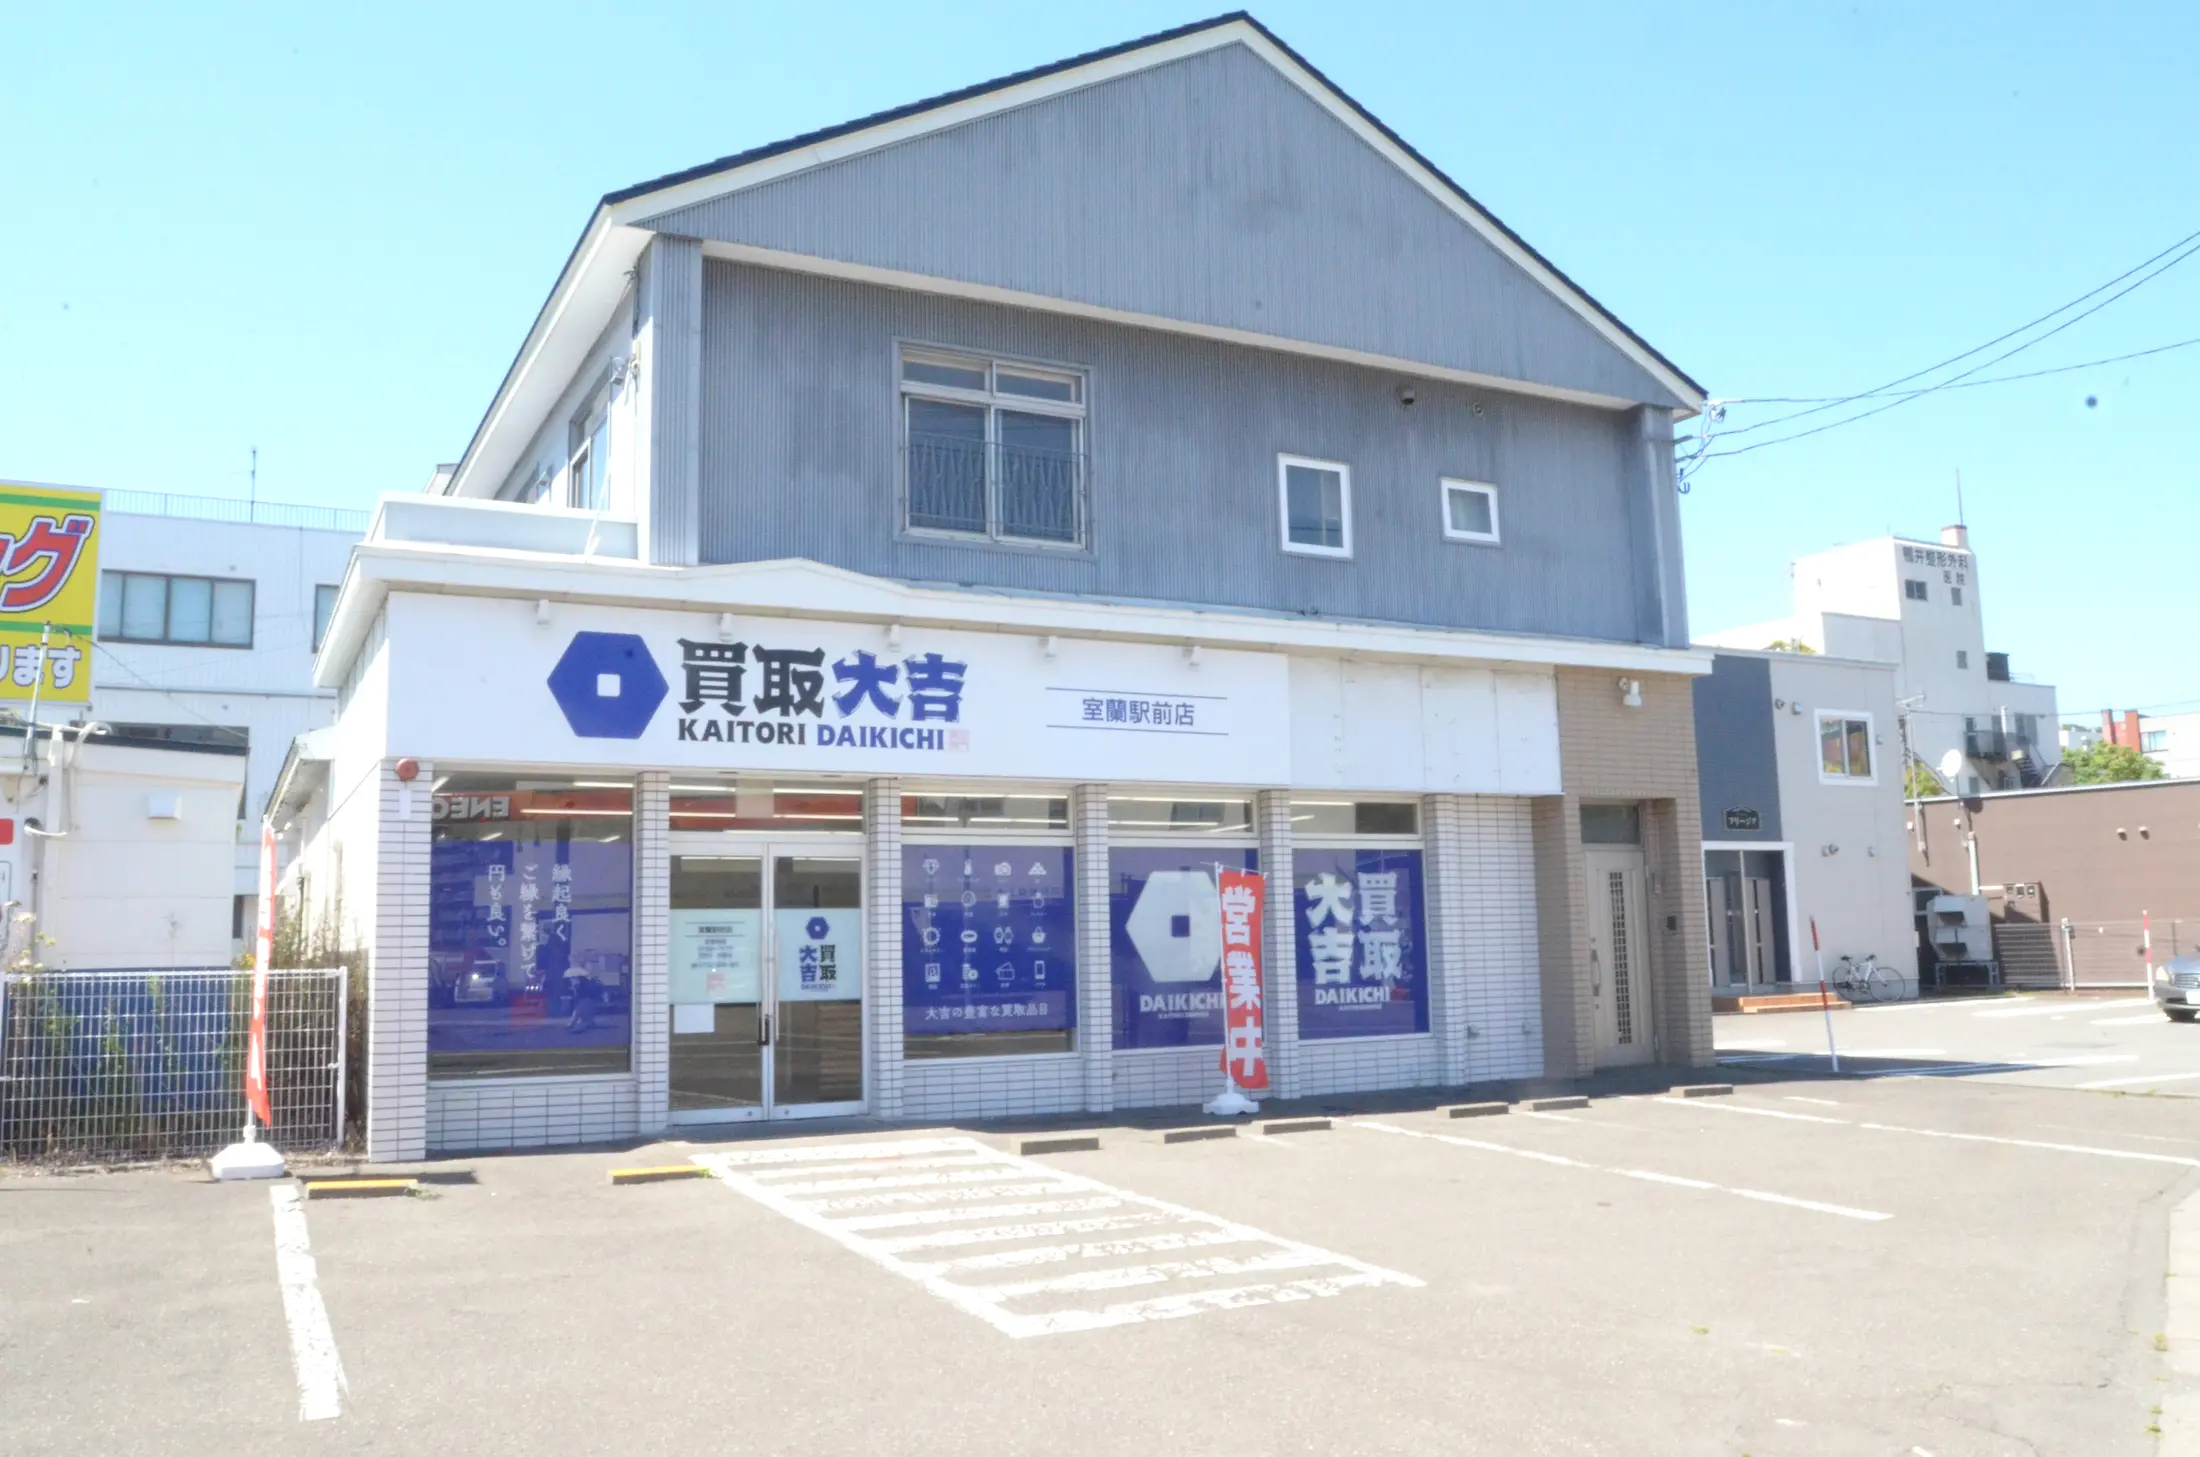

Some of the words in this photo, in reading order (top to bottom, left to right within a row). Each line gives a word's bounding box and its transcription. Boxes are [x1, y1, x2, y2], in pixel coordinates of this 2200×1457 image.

[0, 513, 95, 613] グ
[677, 638, 967, 723] 買取大吉
[1082, 698, 1195, 726] 室蘭駅前店
[677, 718, 806, 746] KAITORI
[817, 724, 945, 750] DAIKICHI
[520, 864, 539, 978] ご縁を繋げて
[552, 864, 572, 941] 縁起良く
[1304, 872, 1355, 985] 大吉
[1357, 872, 1401, 981] 買取
[925, 1002, 1048, 1020] 大吉の豊富な買取品目
[1222, 885, 1262, 1077] 営業中
[1315, 986, 1390, 1005] DAIKICHI
